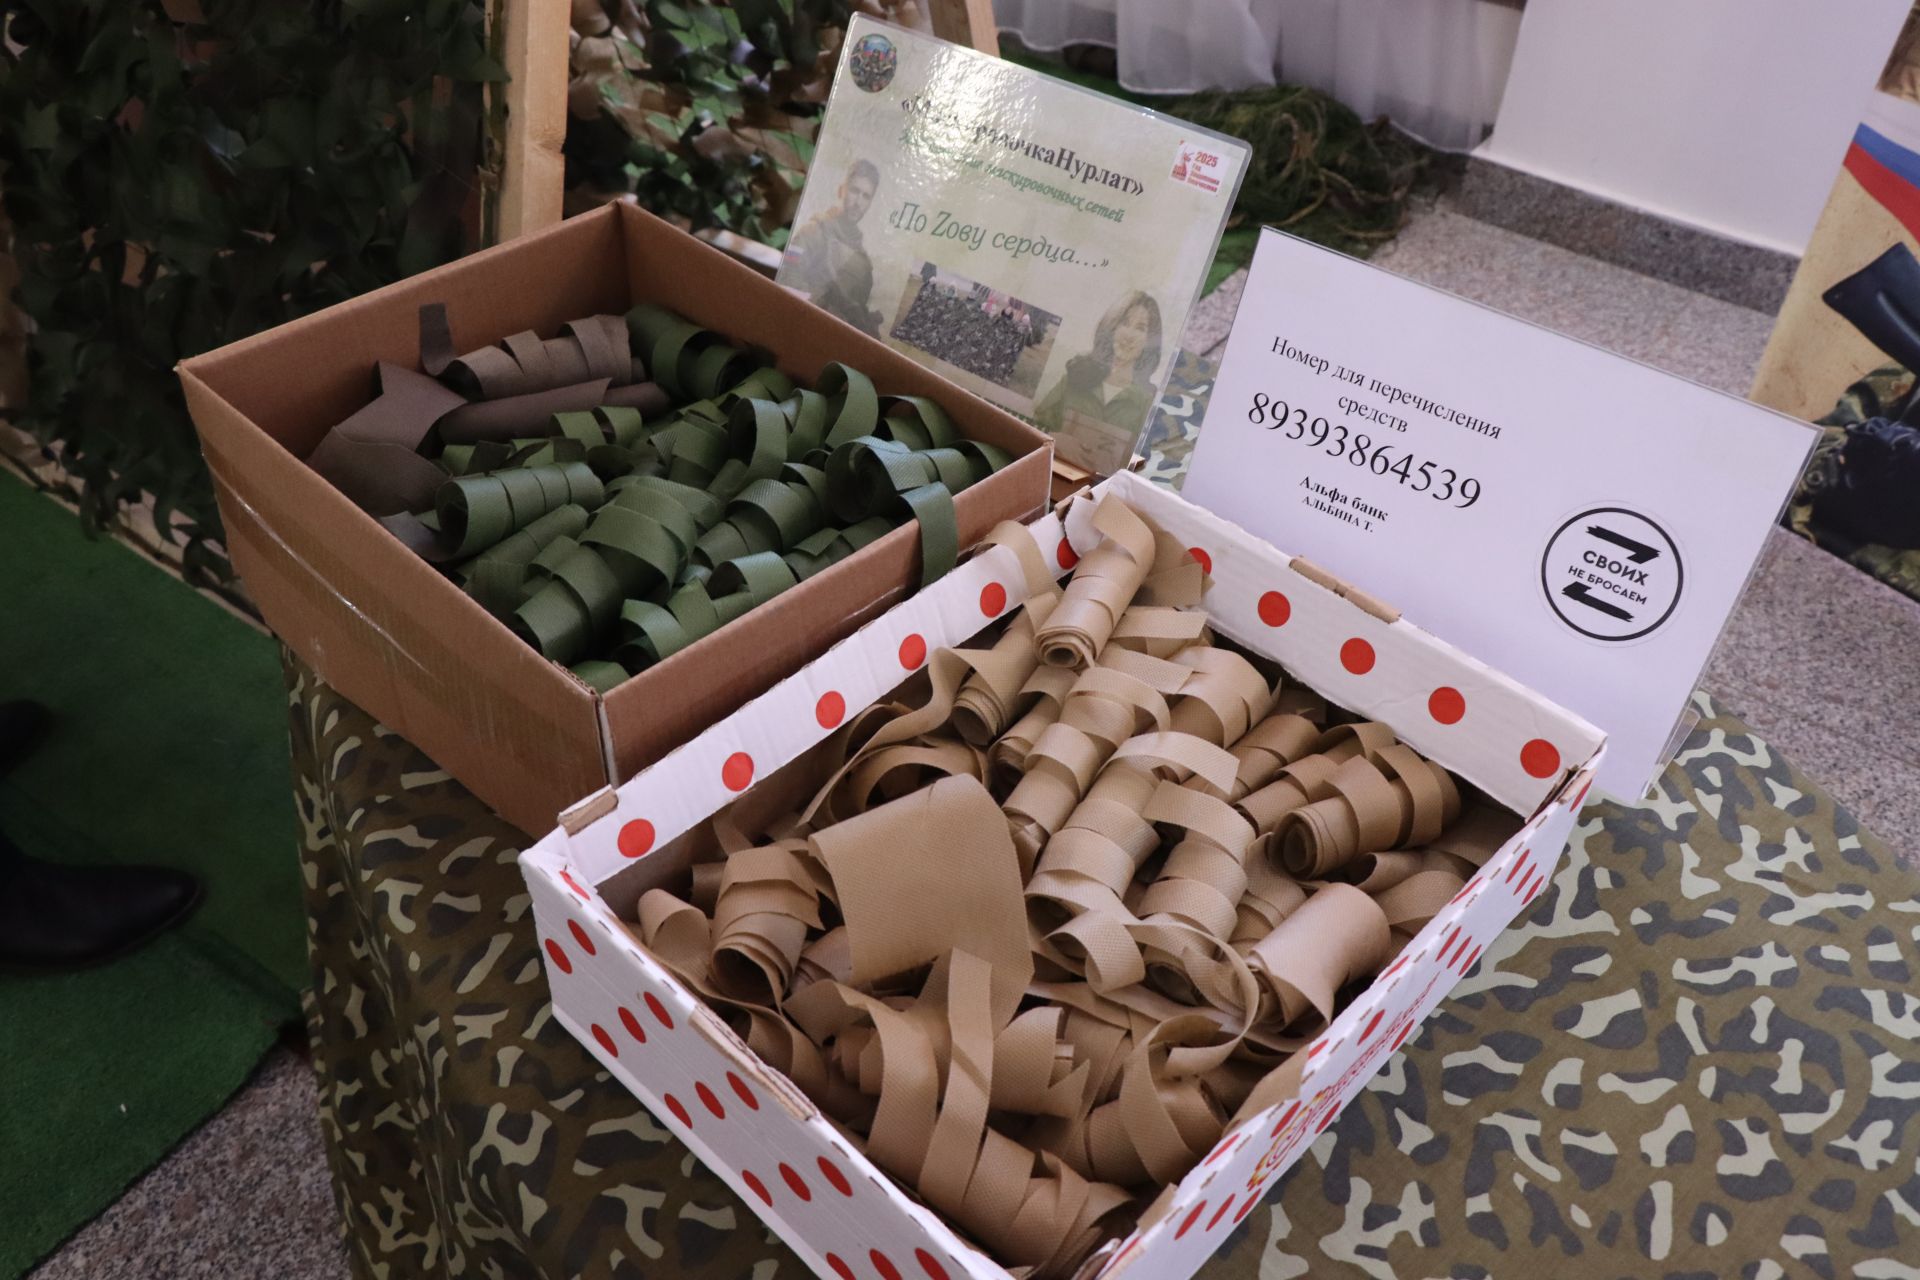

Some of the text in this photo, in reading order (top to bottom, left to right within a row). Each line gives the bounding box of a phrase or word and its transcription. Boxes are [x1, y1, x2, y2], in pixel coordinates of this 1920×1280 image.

[1195, 151, 1219, 168] 2025
[889, 202, 927, 233] «По
[931, 211, 986, 250] Zову
[1084, 199, 1126, 223] сетей
[1271, 336, 1502, 440] Номер для перечисления
[1338, 394, 1408, 433] средств
[1248, 392, 1481, 509] 89393864539
[1299, 476, 1389, 522] Альфа банк
[1301, 496, 1374, 533] АЛЬБИНА Т.
[1568, 565, 1648, 605] НЕ БРОСАЕМ
[1583, 550, 1649, 586] СВОИХ
